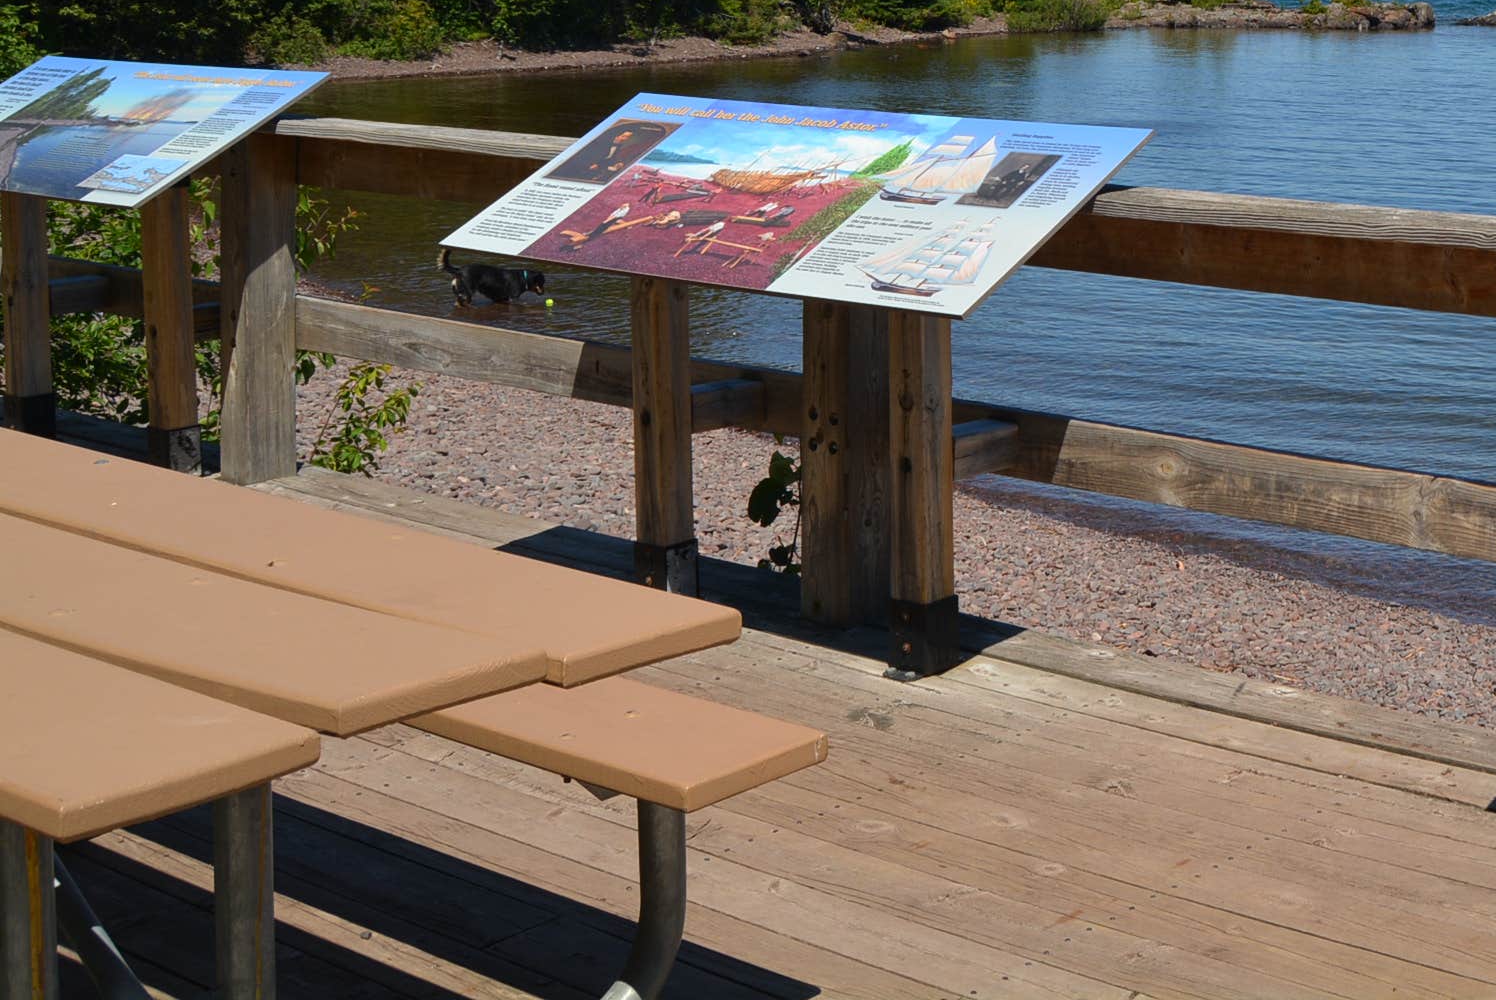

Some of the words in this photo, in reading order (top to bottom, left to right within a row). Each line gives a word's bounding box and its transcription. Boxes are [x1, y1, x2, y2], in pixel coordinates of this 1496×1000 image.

[664, 106, 690, 116] will
[691, 108, 713, 119] call
[715, 110, 736, 120] her
[738, 112, 760, 122] the
[762, 114, 795, 125] John
[796, 116, 836, 128] Jacob
